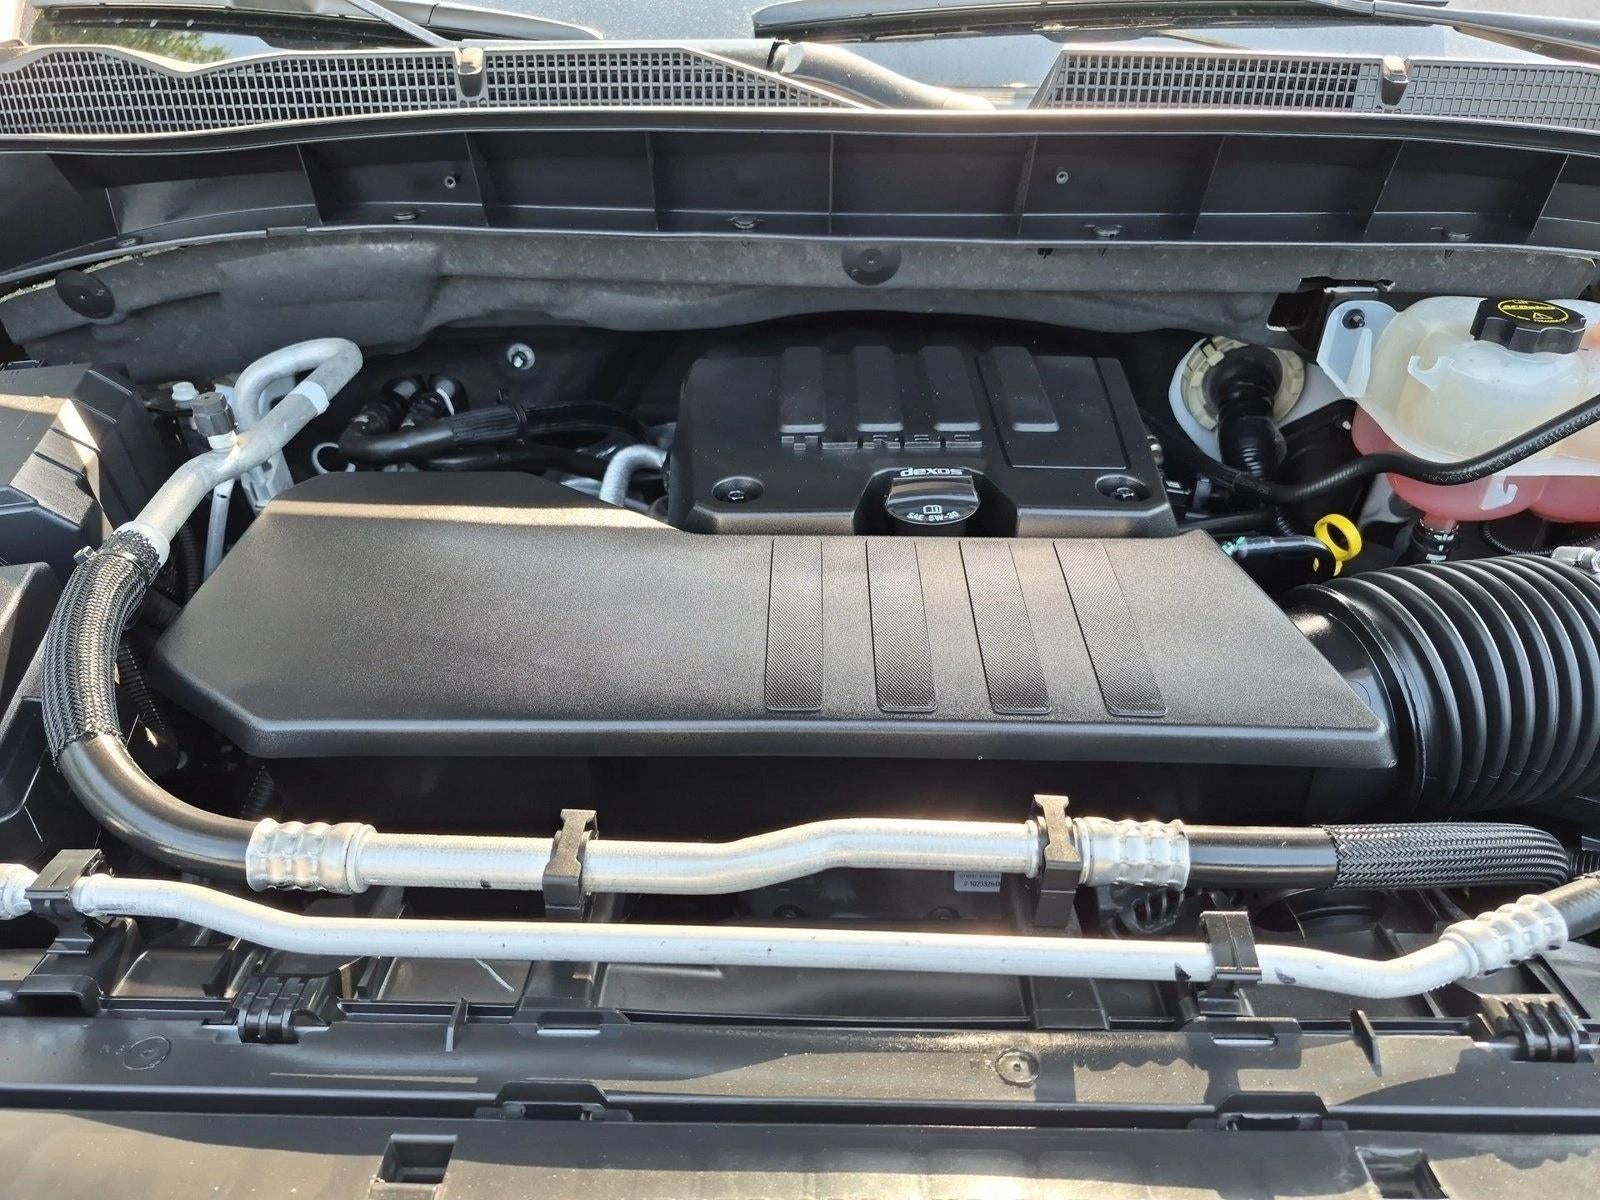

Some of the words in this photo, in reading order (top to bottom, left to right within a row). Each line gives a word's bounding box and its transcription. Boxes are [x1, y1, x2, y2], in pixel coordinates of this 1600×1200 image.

[900, 467, 964, 477] dexos
[906, 512, 925, 521] SAE
[928, 511, 960, 522] 5W-30
